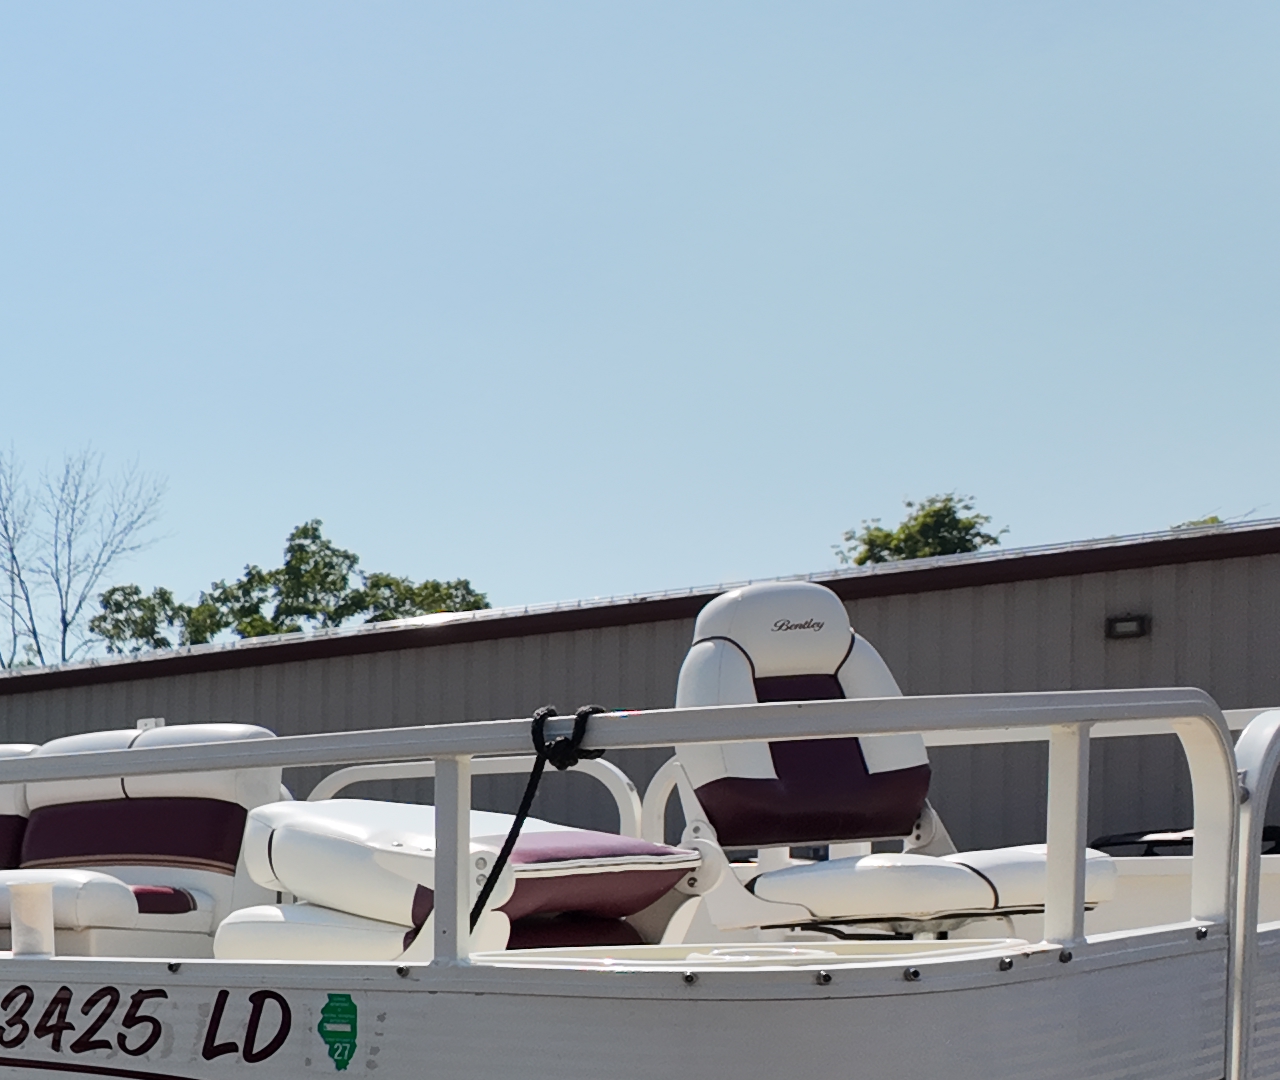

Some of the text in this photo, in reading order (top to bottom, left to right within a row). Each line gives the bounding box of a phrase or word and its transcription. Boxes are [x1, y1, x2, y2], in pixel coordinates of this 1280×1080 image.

[771, 618, 825, 632] Bentley
[202, 989, 292, 1063] LD
[333, 1042, 351, 1060] 27
